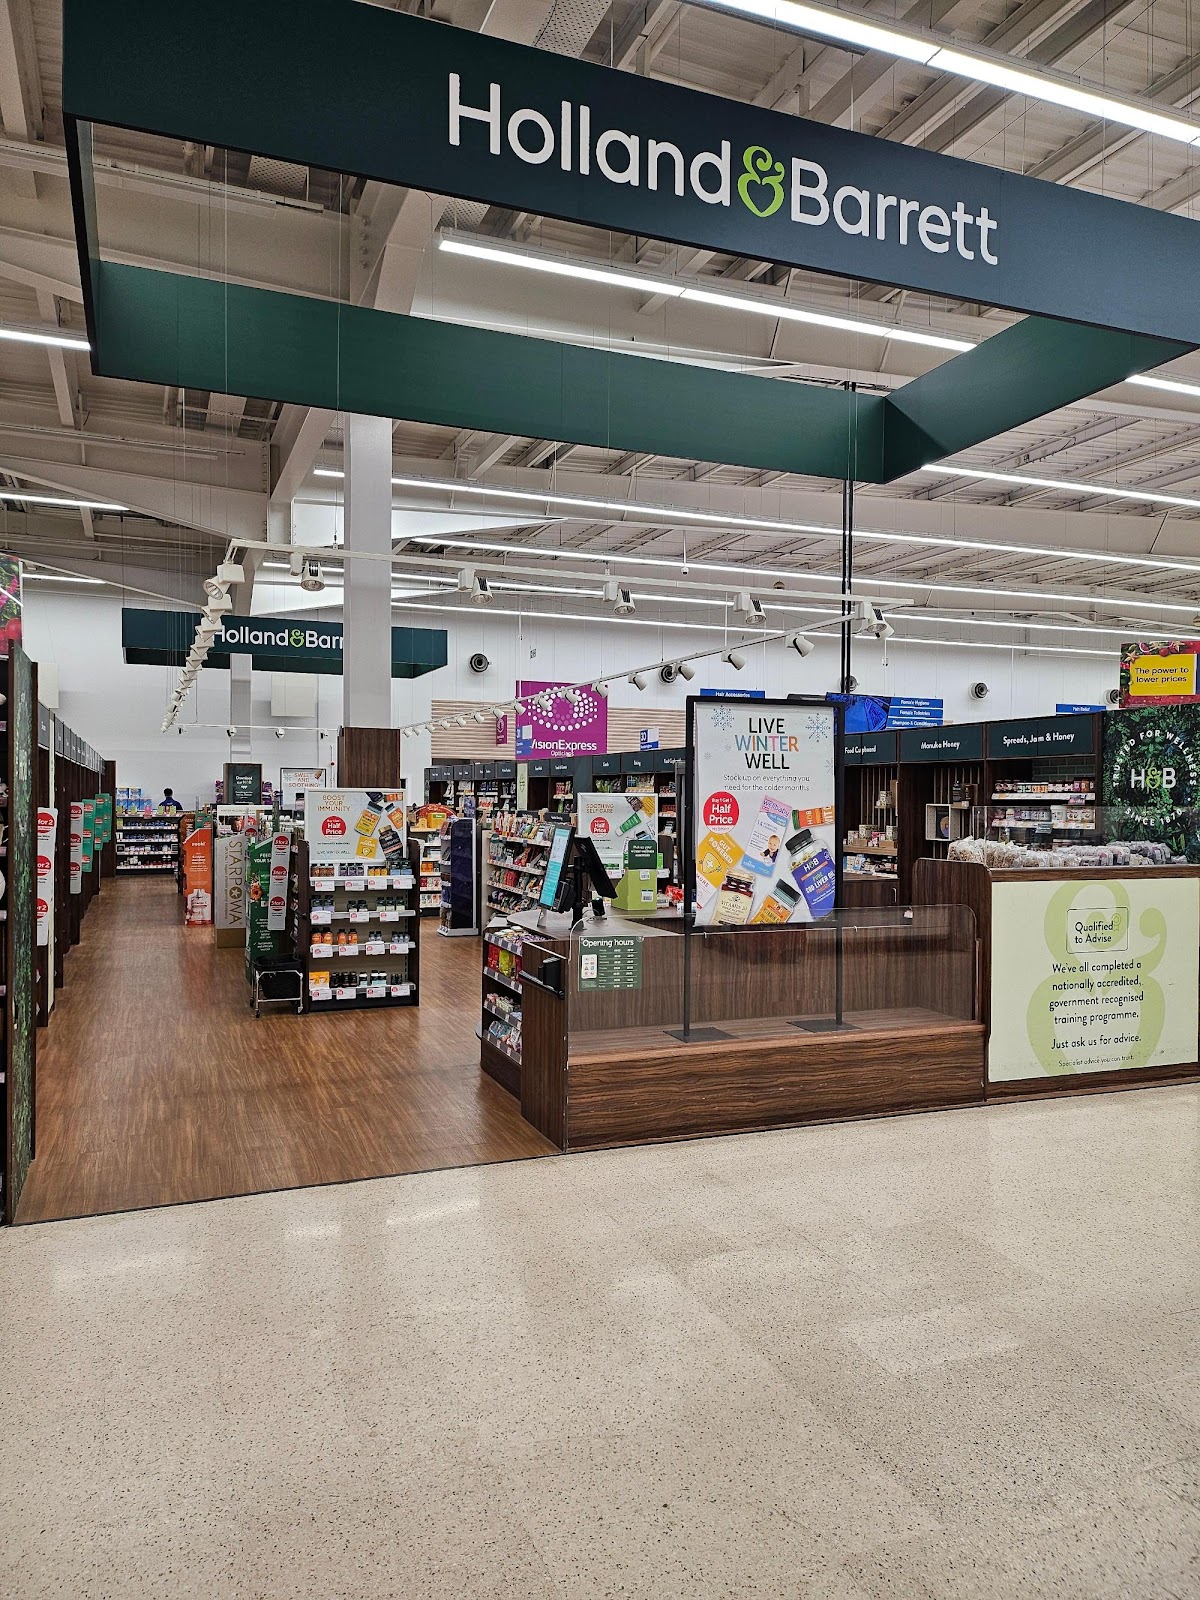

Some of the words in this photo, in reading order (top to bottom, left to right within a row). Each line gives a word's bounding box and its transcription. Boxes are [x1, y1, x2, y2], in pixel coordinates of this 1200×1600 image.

[448, 72, 998, 266] Holland&Barrett
[1151, 668, 1178, 676] power
[1161, 676, 1187, 684] prices
[748, 718, 785, 734] LIVE
[734, 735, 799, 752] WINTER
[921, 741, 942, 749] Manuka
[943, 740, 960, 750] Honey
[1003, 736, 1029, 747] Spreads,
[1030, 734, 1044, 744] Jam
[1045, 733, 1051, 741] &
[1052, 732, 1075, 742] Honey
[744, 753, 790, 770] WELL
[1113, 738, 1136, 787] TRUSTED
[1139, 729, 1161, 741] FOR
[1166, 731, 1197, 786] WELLNESS
[762, 774, 797, 782] everything
[712, 804, 732, 814] Half
[710, 814, 733, 824] Price
[1124, 808, 1155, 826] SINCE
[1160, 808, 1183, 825] 1870
[1075, 921, 1114, 934] Qualified
[583, 939, 613, 948] Opening
[1075, 936, 1083, 944] to
[1085, 935, 1112, 943] Advise
[1052, 963, 1077, 974] We've
[1080, 962, 1089, 972] all
[1091, 959, 1134, 974] completed
[1052, 979, 1094, 992] nationally
[1096, 975, 1142, 988] accredited,
[1049, 996, 1099, 1012] government
[1101, 991, 1144, 1007] recognised
[1054, 1013, 1088, 1026] training
[1090, 1011, 1139, 1025] programme.
[1051, 1039, 1069, 1050] Just
[1071, 1036, 1086, 1048] ask
[1100, 1034, 1112, 1045] for
[1114, 1032, 1142, 1044] advice.
